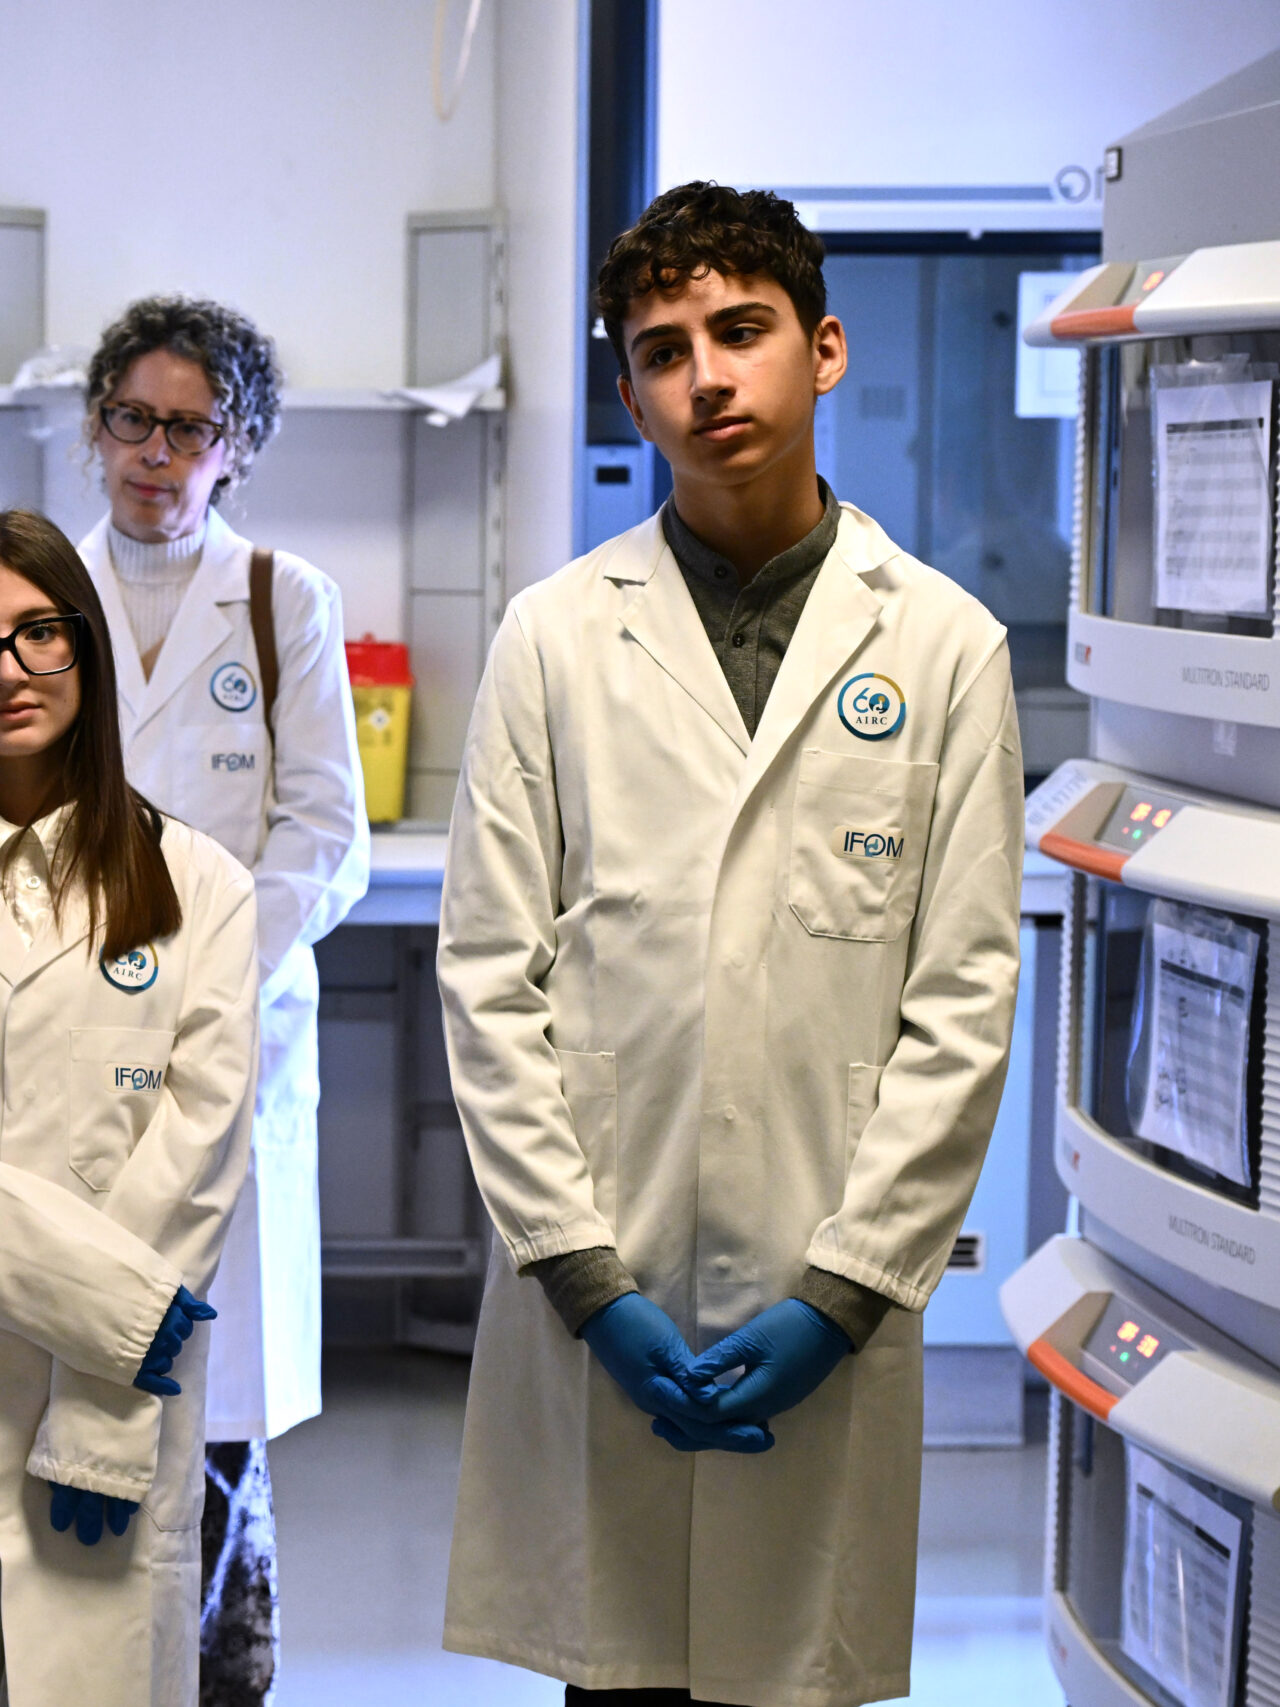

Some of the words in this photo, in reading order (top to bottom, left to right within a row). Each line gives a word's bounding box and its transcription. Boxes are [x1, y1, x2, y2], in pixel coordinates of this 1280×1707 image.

[1224, 669, 1270, 692] STANDARD
[855, 716, 888, 726] AIRC
[211, 752, 255, 771] IFOM
[843, 831, 905, 858] IFOM
[113, 966, 143, 981] AIRC
[115, 1067, 163, 1090] IFOM
